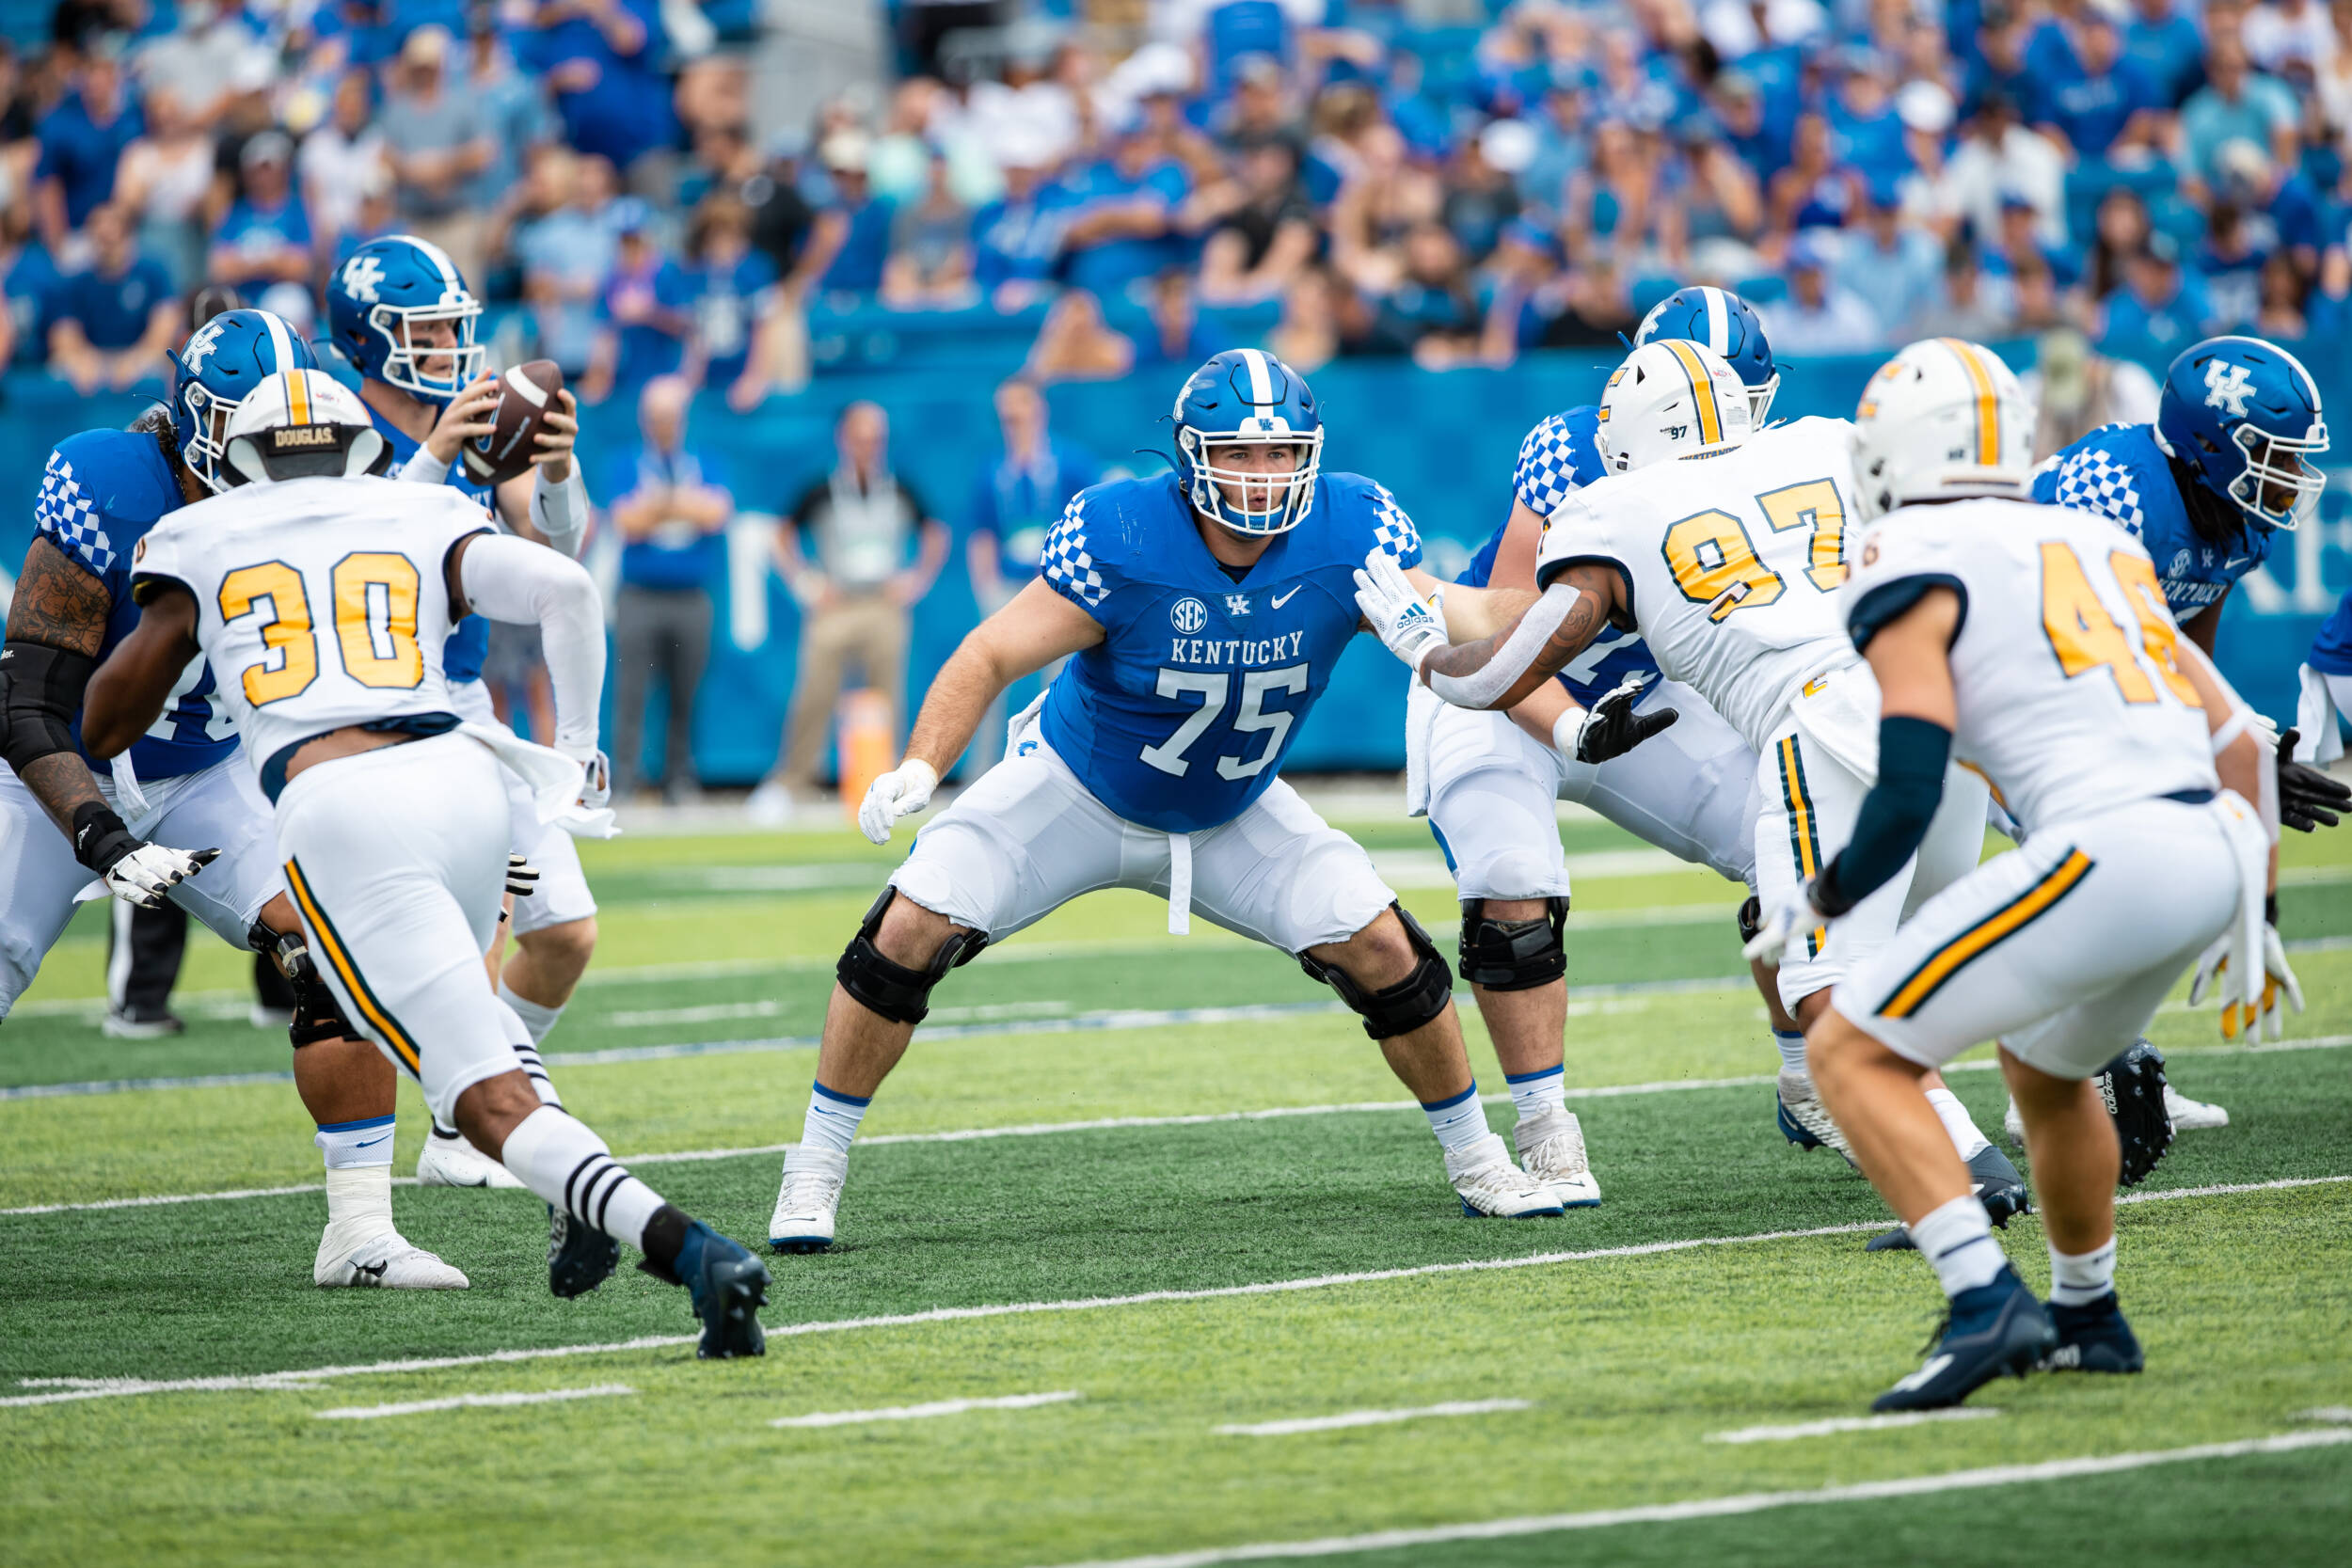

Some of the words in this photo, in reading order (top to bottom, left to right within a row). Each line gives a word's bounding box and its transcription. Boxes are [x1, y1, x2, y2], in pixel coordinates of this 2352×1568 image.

[1671, 425, 1687, 439] 97
[1661, 477, 1847, 626] 97
[217, 551, 426, 709] 30
[1174, 600, 1204, 632] SEC
[1397, 615, 1435, 629] adidas
[1170, 629, 1304, 665] KENTUCKY
[1138, 662, 1310, 781] 75
[2103, 1070, 2119, 1115] adidas
